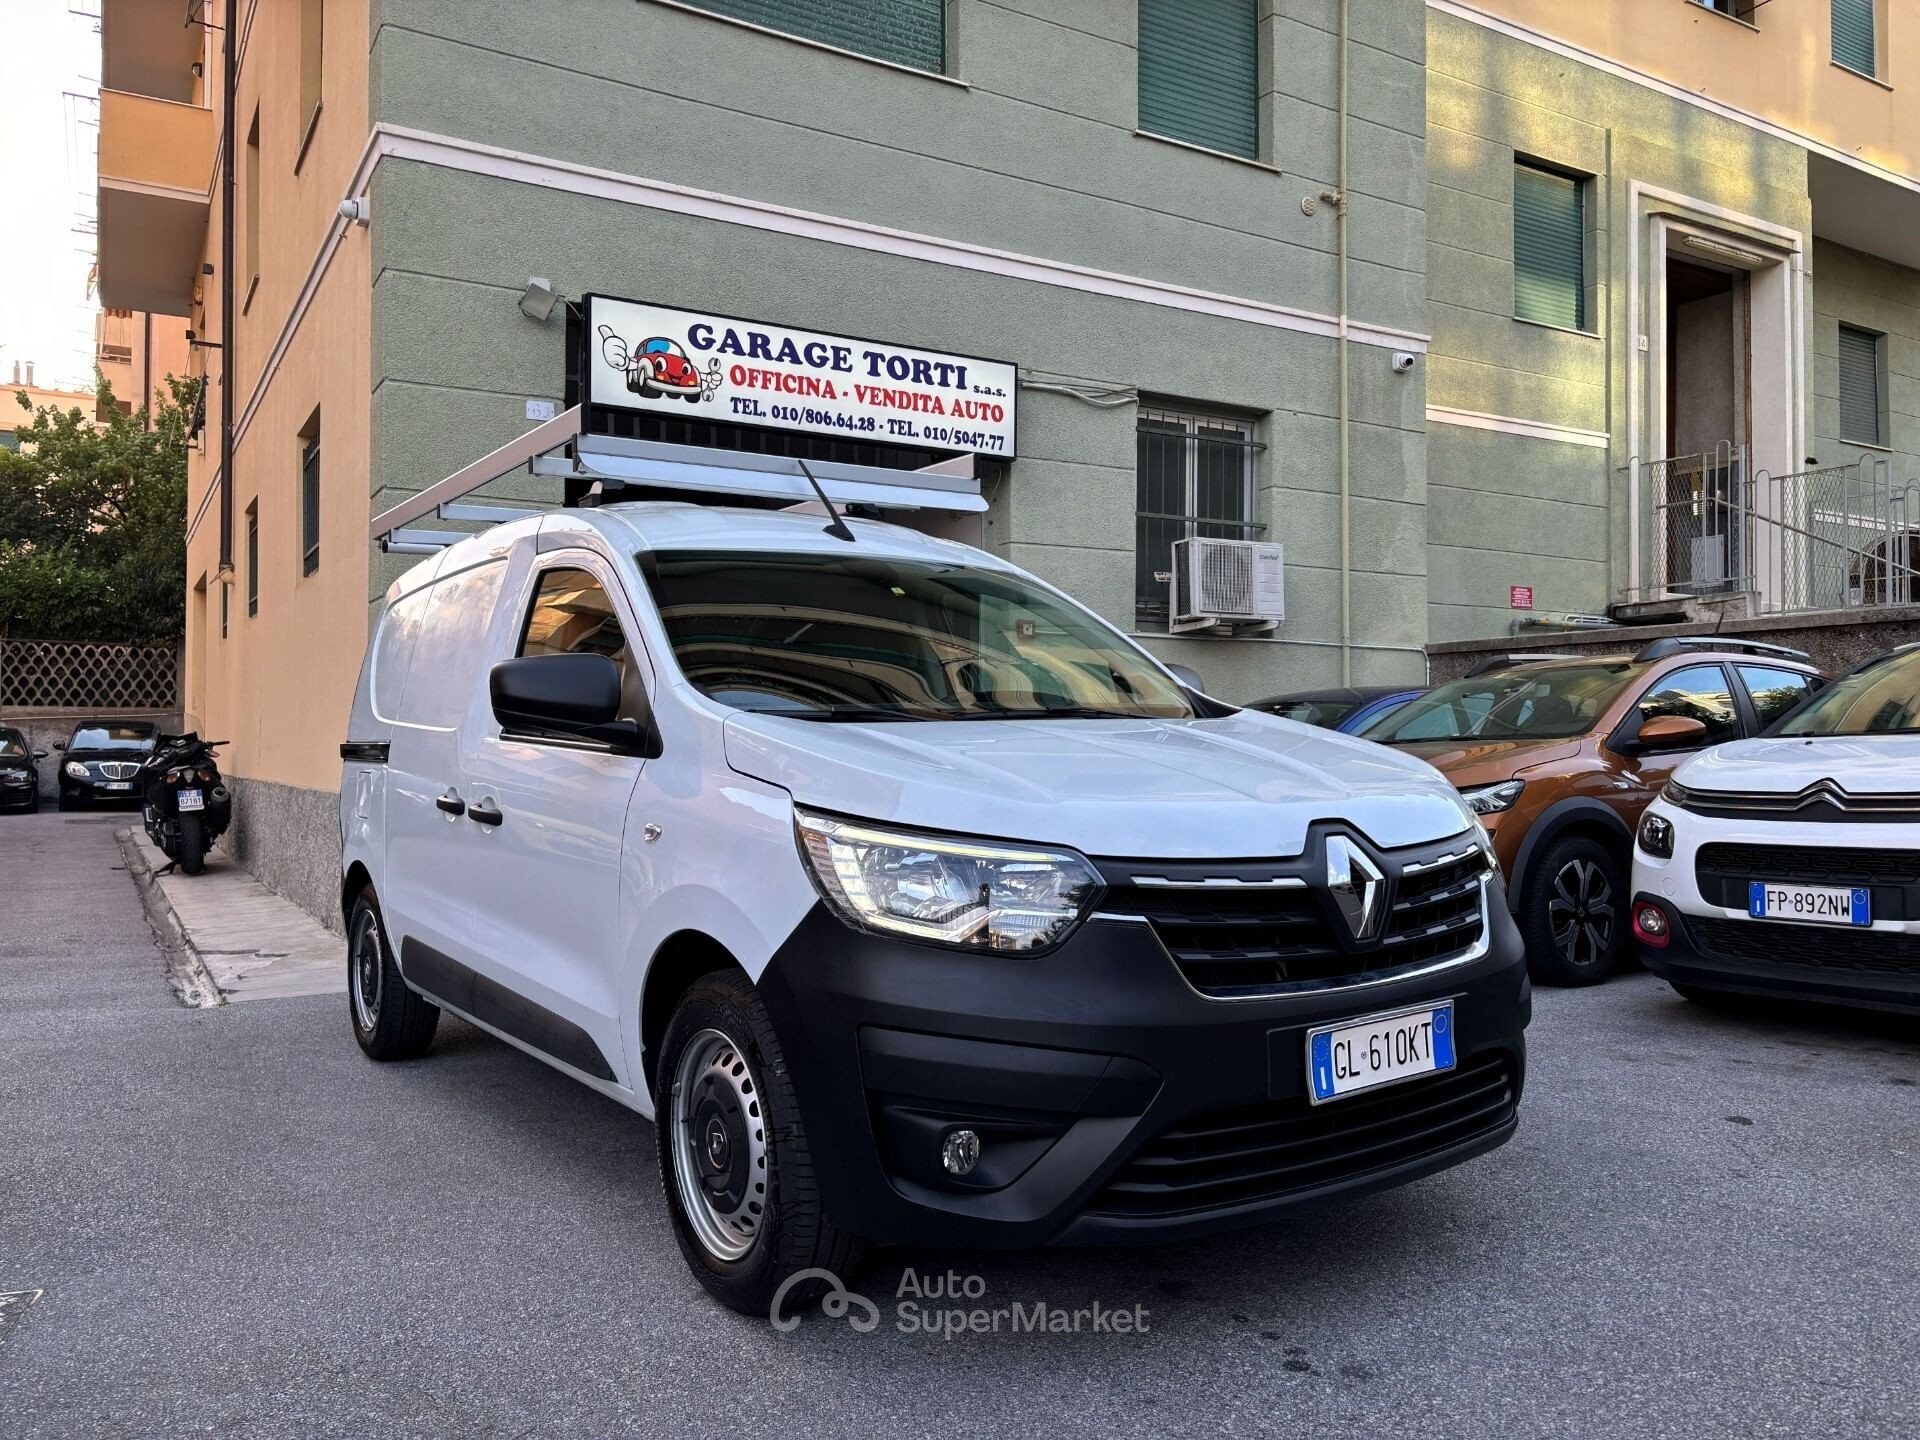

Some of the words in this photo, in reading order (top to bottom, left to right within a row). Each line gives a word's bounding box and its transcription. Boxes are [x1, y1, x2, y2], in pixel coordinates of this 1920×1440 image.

[688, 323, 853, 373] GARAGE
[863, 350, 968, 390] TORTI
[973, 384, 1007, 397] s.a.s.
[730, 364, 838, 400] OFFICINA
[854, 383, 946, 416] VENDITA
[950, 399, 1004, 423] AUTO
[730, 396, 767, 418] TEL.
[771, 405, 875, 431] 010/806.64.28
[887, 418, 920, 438] TEL.
[923, 425, 1005, 451] 010/5047.77
[1767, 891, 1788, 911] FP
[1794, 893, 1850, 916] 892NW
[1334, 1040, 1360, 1080] GL
[1369, 1021, 1432, 1071] 610KT
